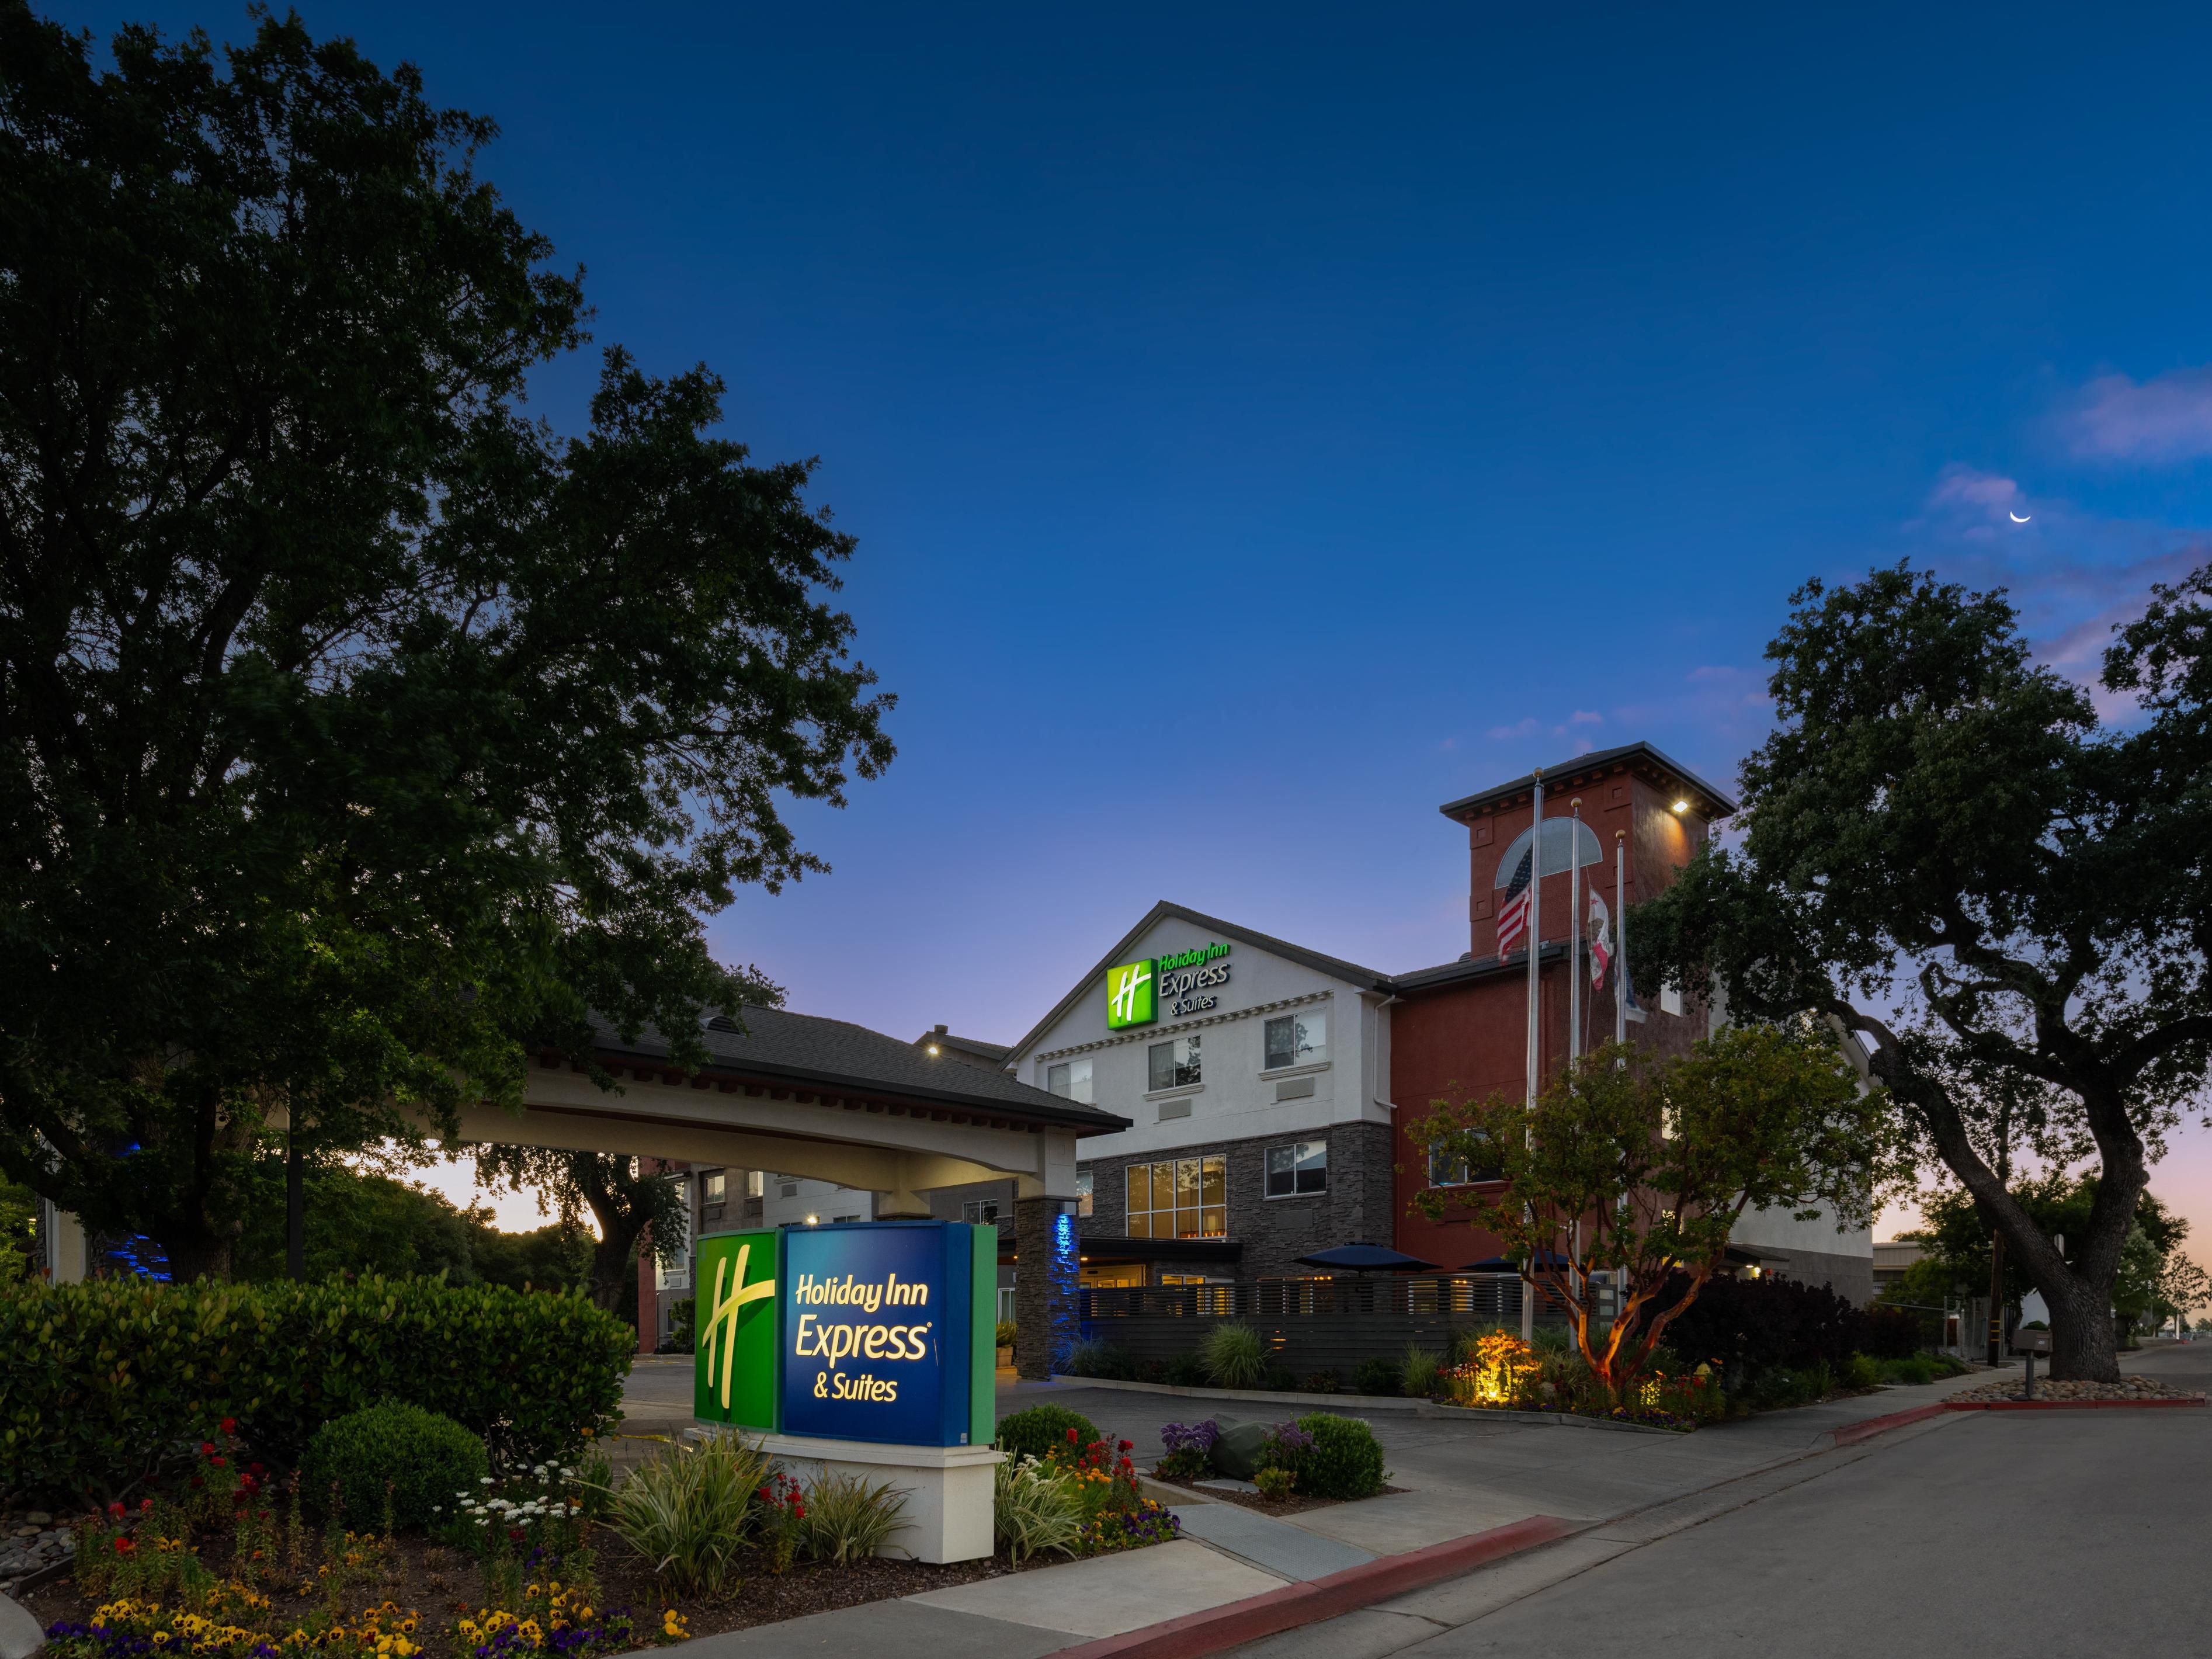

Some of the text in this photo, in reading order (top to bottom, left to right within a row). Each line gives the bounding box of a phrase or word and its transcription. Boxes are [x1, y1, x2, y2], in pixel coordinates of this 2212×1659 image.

[1159, 942, 1230, 972] Holiday Inn
[1159, 963, 1230, 999] Express
[1171, 995, 1217, 1016] & Suites
[796, 1273, 929, 1313] Holiday Inn
[814, 1371, 898, 1402] & Suites
